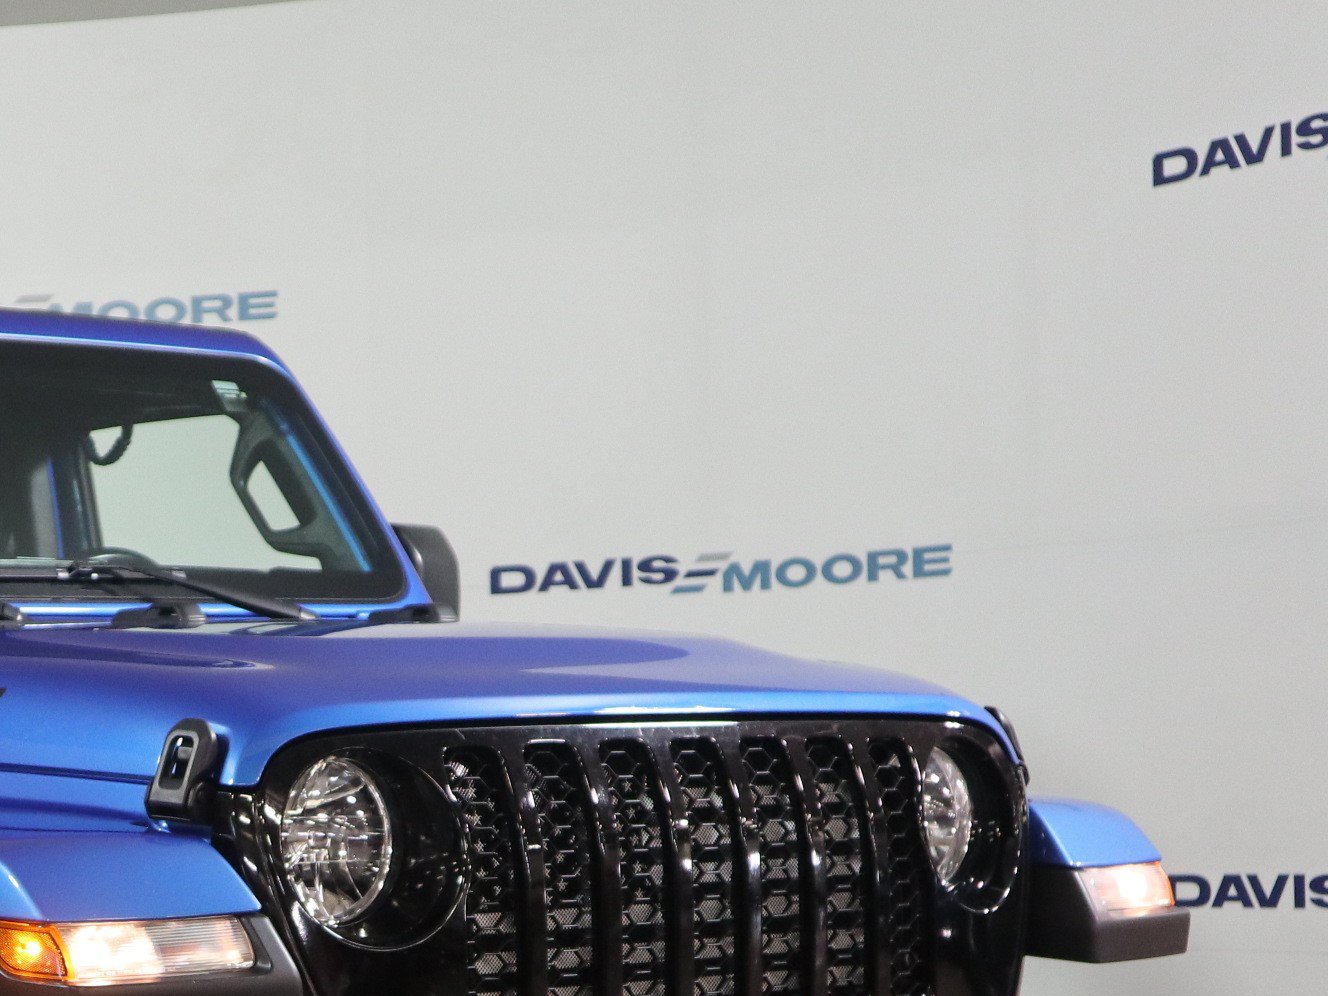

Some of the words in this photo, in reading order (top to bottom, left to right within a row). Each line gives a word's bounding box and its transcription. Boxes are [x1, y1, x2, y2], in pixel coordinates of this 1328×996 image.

[1152, 112, 1328, 187] DAVIS
[489, 554, 680, 595] DAVIS
[722, 544, 953, 593] MOORE
